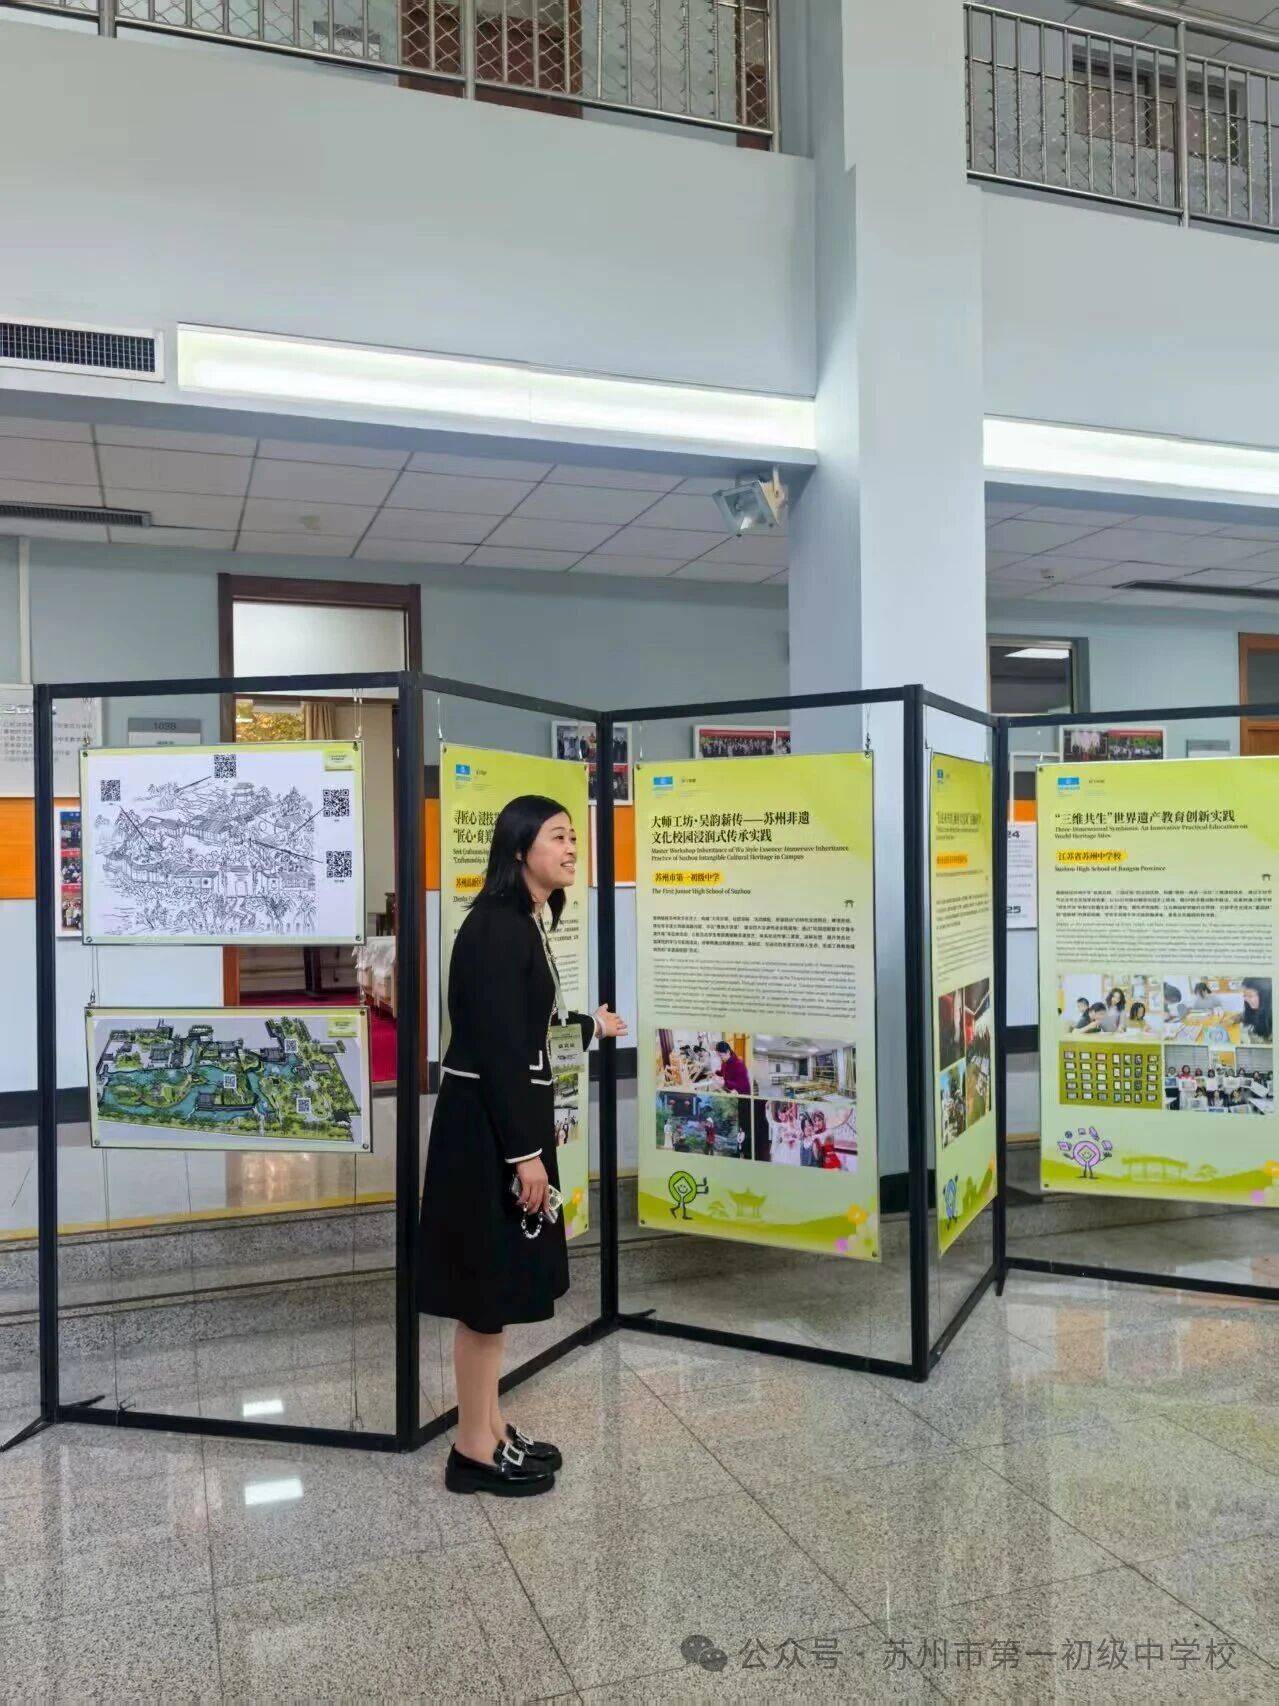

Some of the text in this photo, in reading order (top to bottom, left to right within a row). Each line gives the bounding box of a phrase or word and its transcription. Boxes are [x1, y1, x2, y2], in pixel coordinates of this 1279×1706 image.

[652, 828, 773, 844] 文化校园浸润式传承实践
[669, 847, 696, 855] Workshop
[781, 853, 804, 861] Campus
[655, 872, 720, 882] 苏州市第一初级中学
